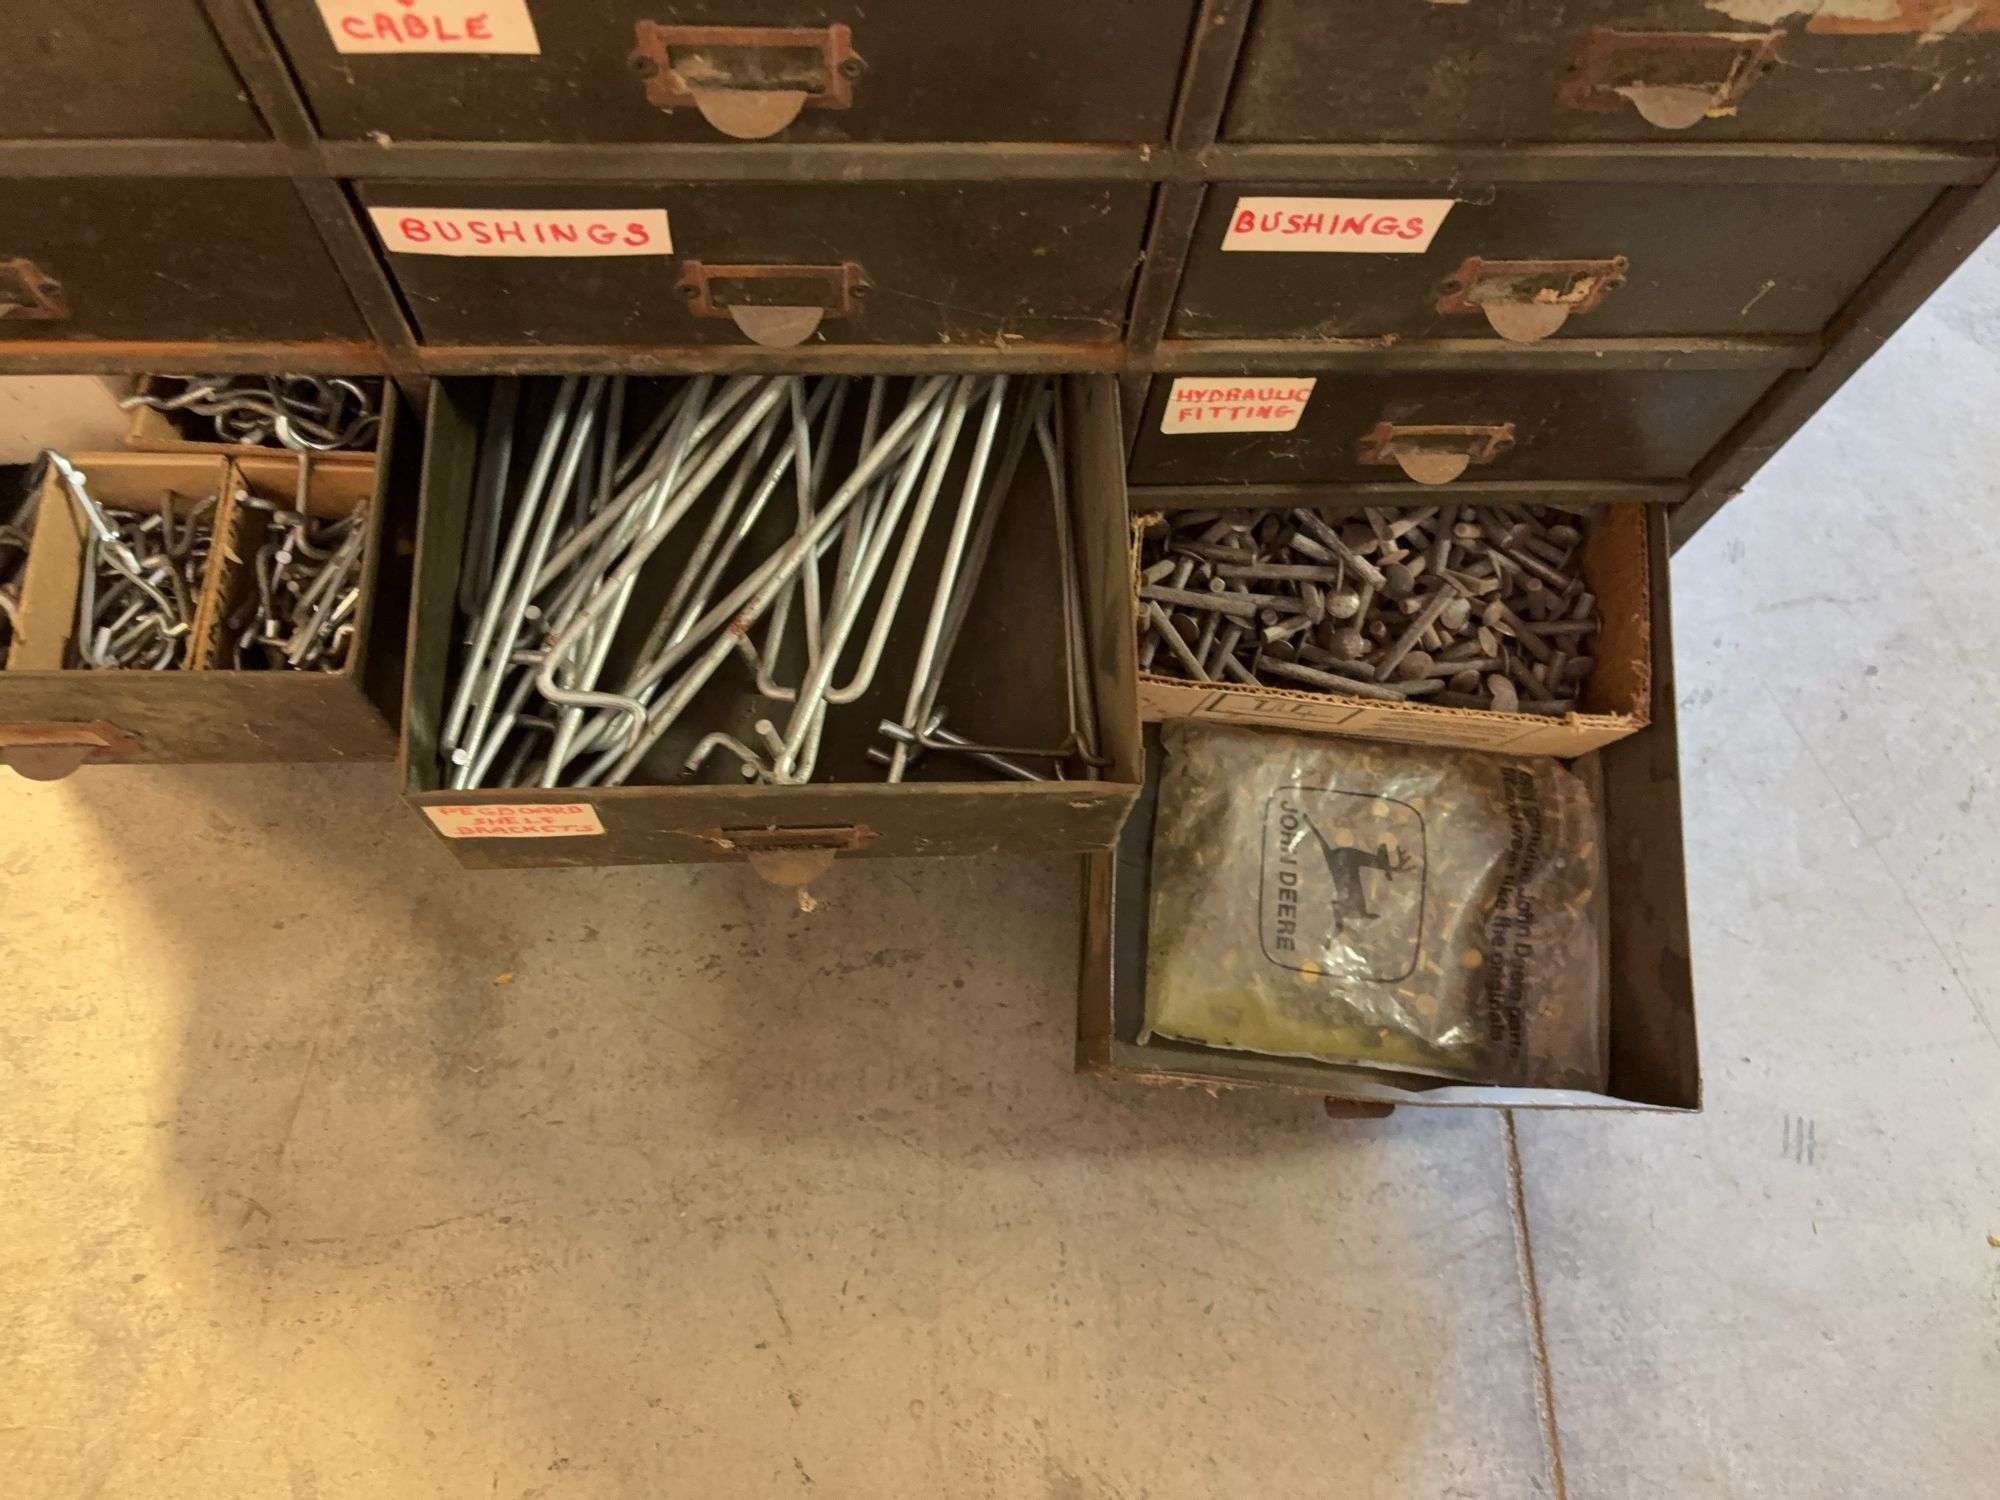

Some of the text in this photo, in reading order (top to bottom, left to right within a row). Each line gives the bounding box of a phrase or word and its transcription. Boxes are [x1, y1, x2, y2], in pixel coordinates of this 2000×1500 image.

[341, 13, 493, 43] CABLE
[400, 217, 650, 246] BUSHINGS
[1234, 210, 1424, 239] BUSHINGS
[1177, 387, 1311, 402] HYDRAULIC
[1178, 405, 1295, 422] FITTING
[454, 824, 594, 835] BRACKETS
[1276, 871, 1297, 951] DEERE
